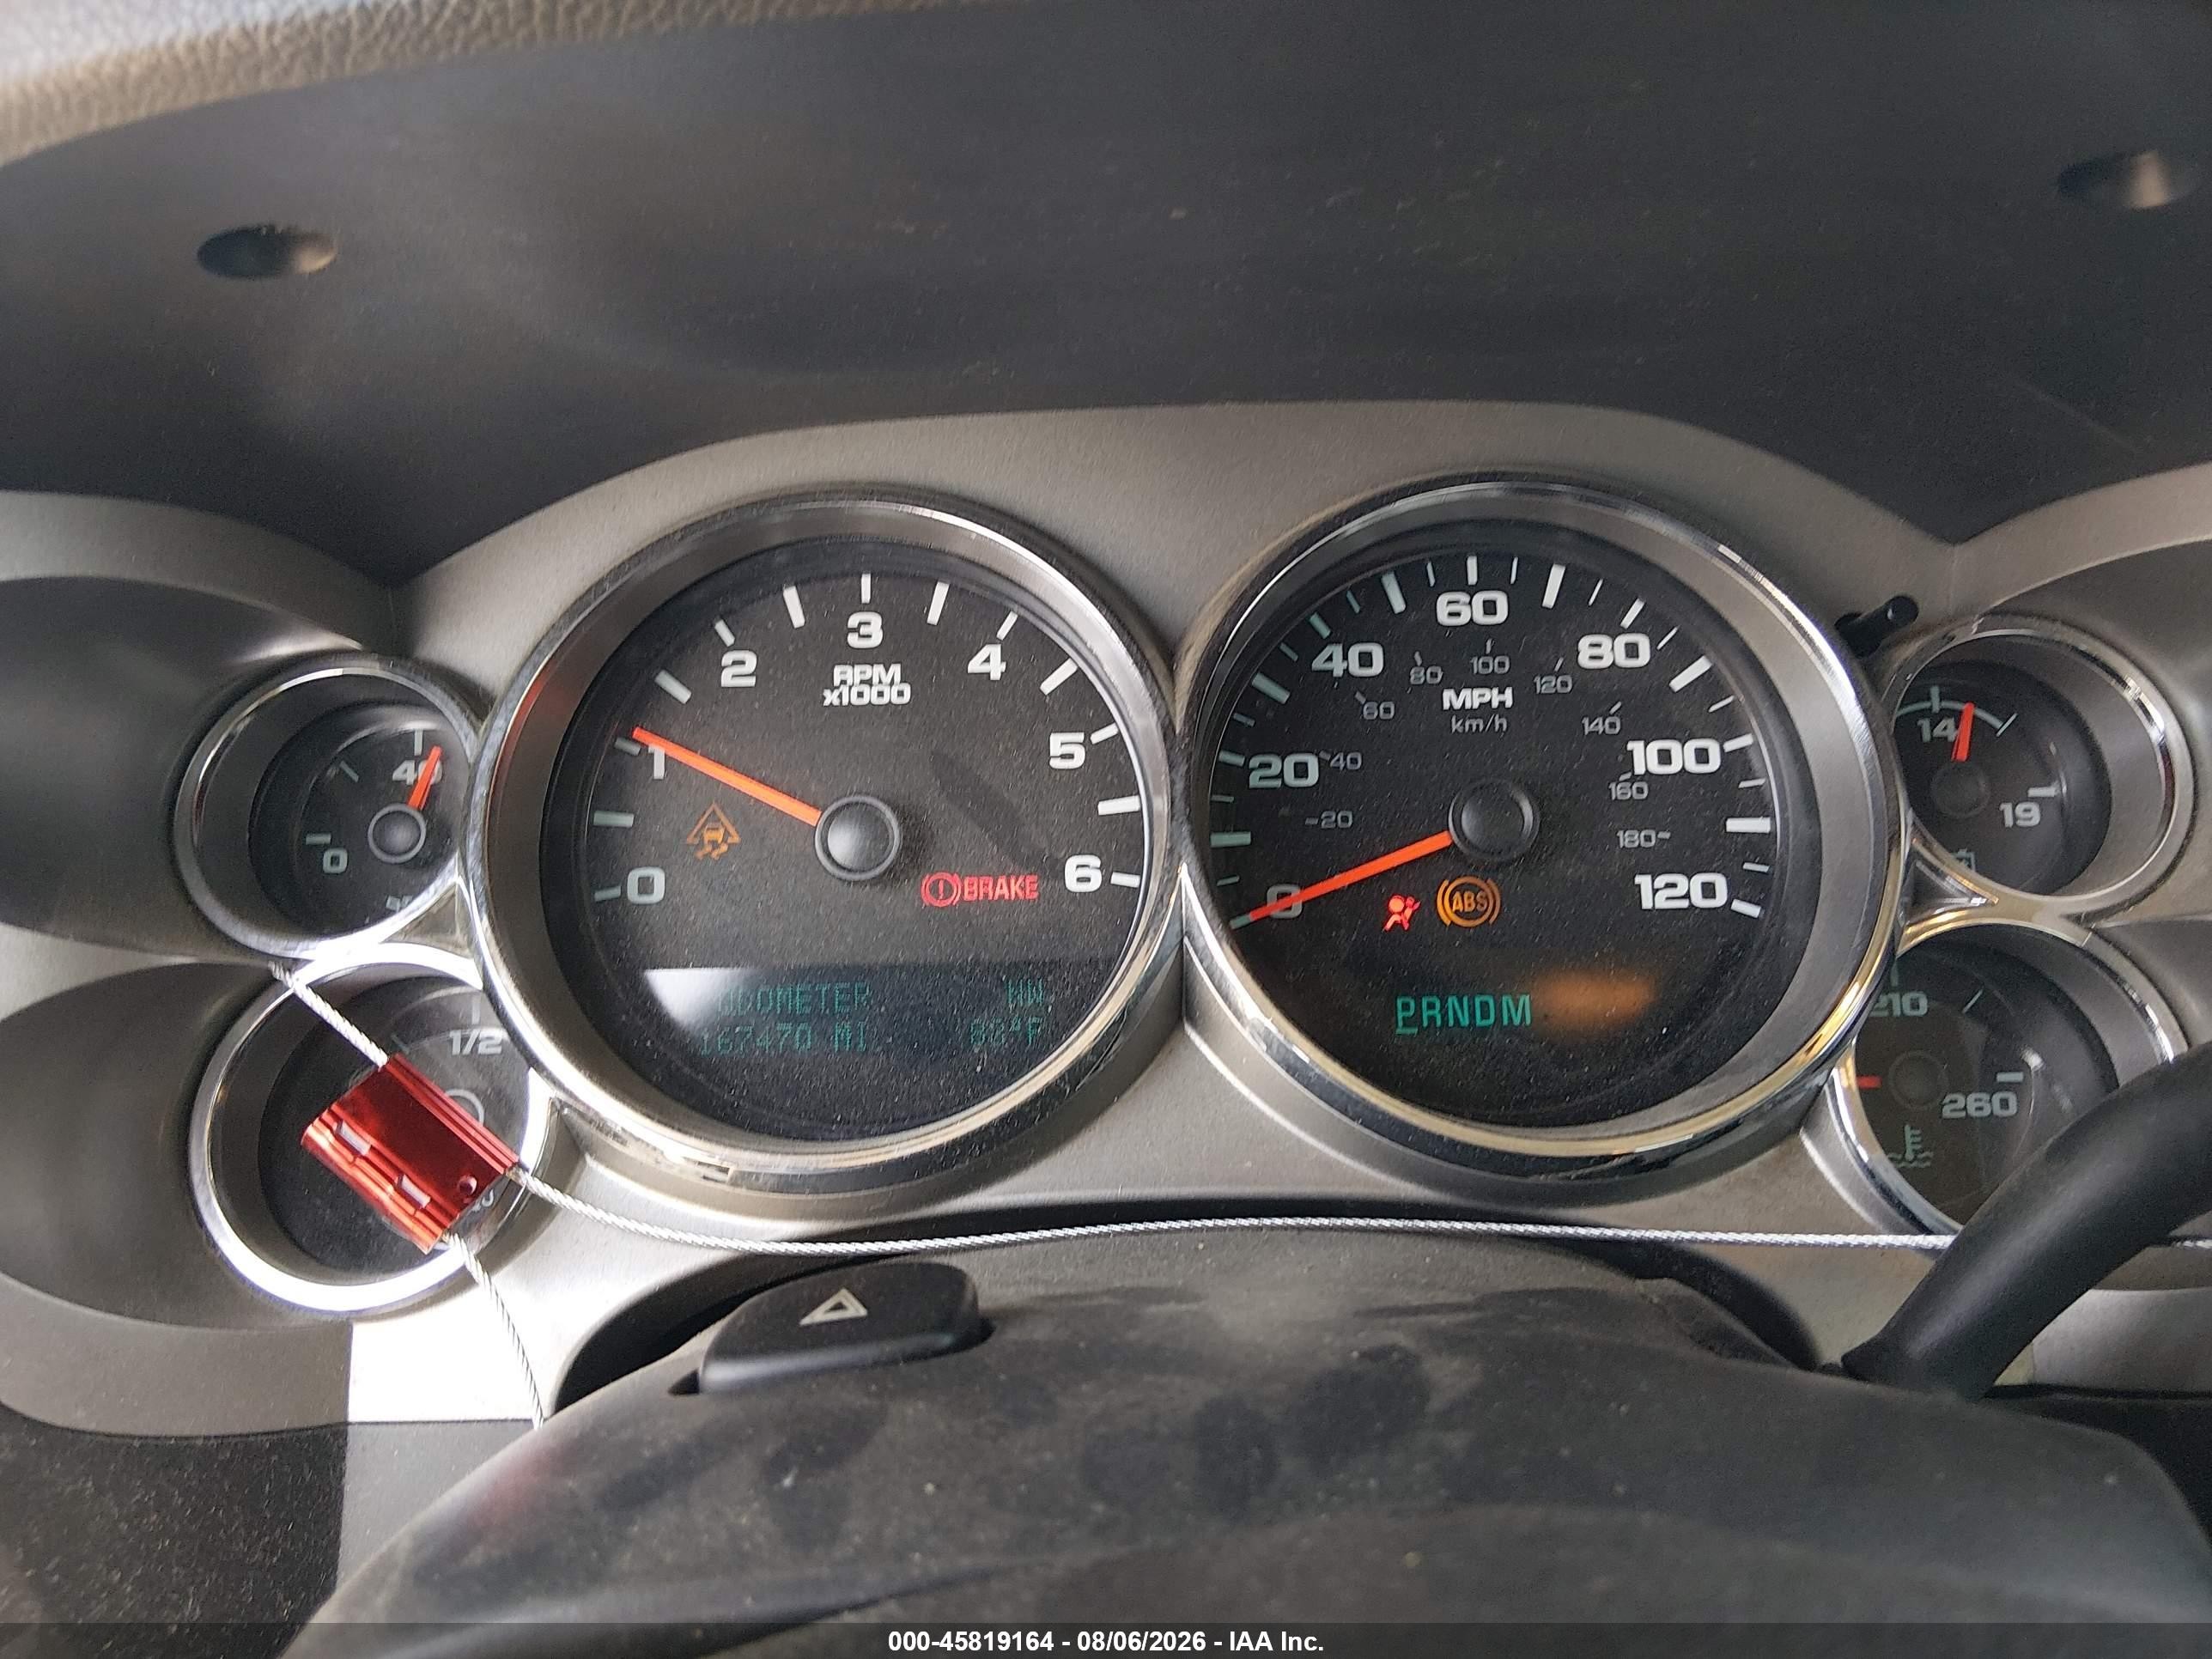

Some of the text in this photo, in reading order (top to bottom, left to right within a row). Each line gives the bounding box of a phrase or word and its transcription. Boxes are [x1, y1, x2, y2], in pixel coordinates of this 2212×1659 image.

[1436, 590, 1509, 626] 60
[847, 612, 883, 648] 3
[968, 644, 1006, 681] 4
[1311, 642, 1384, 677] 40
[1577, 633, 1650, 669] 80
[720, 650, 757, 687] 2
[833, 664, 902, 686] RPM
[1410, 665, 1443, 685] 80
[1470, 655, 1510, 675] 100
[822, 682, 911, 707] x1000
[1534, 675, 1573, 695] 120
[1362, 701, 1395, 720] 60
[1443, 687, 1514, 711] MPH
[1450, 714, 1509, 734] km/h
[1582, 716, 1621, 736] 140
[1917, 717, 1960, 743] 14
[648, 744, 665, 779] 1
[1049, 732, 1085, 769] 5
[1330, 752, 1363, 771] 40
[1627, 738, 1722, 775] 100
[1249, 752, 1320, 788] 20
[1608, 781, 1649, 800] 160
[1321, 810, 1353, 829] 20
[1999, 801, 2041, 828] 19
[1616, 830, 1656, 848] 180
[323, 848, 348, 873] 0
[627, 867, 665, 904] 0
[1064, 855, 1103, 893] 6
[963, 874, 1038, 901] BRAKE
[1635, 872, 1729, 911] 120
[1267, 884, 1303, 919] 0
[1452, 890, 1488, 912] ABS
[449, 1030, 502, 1055] 1/2
[1942, 1091, 2019, 1119] 260
